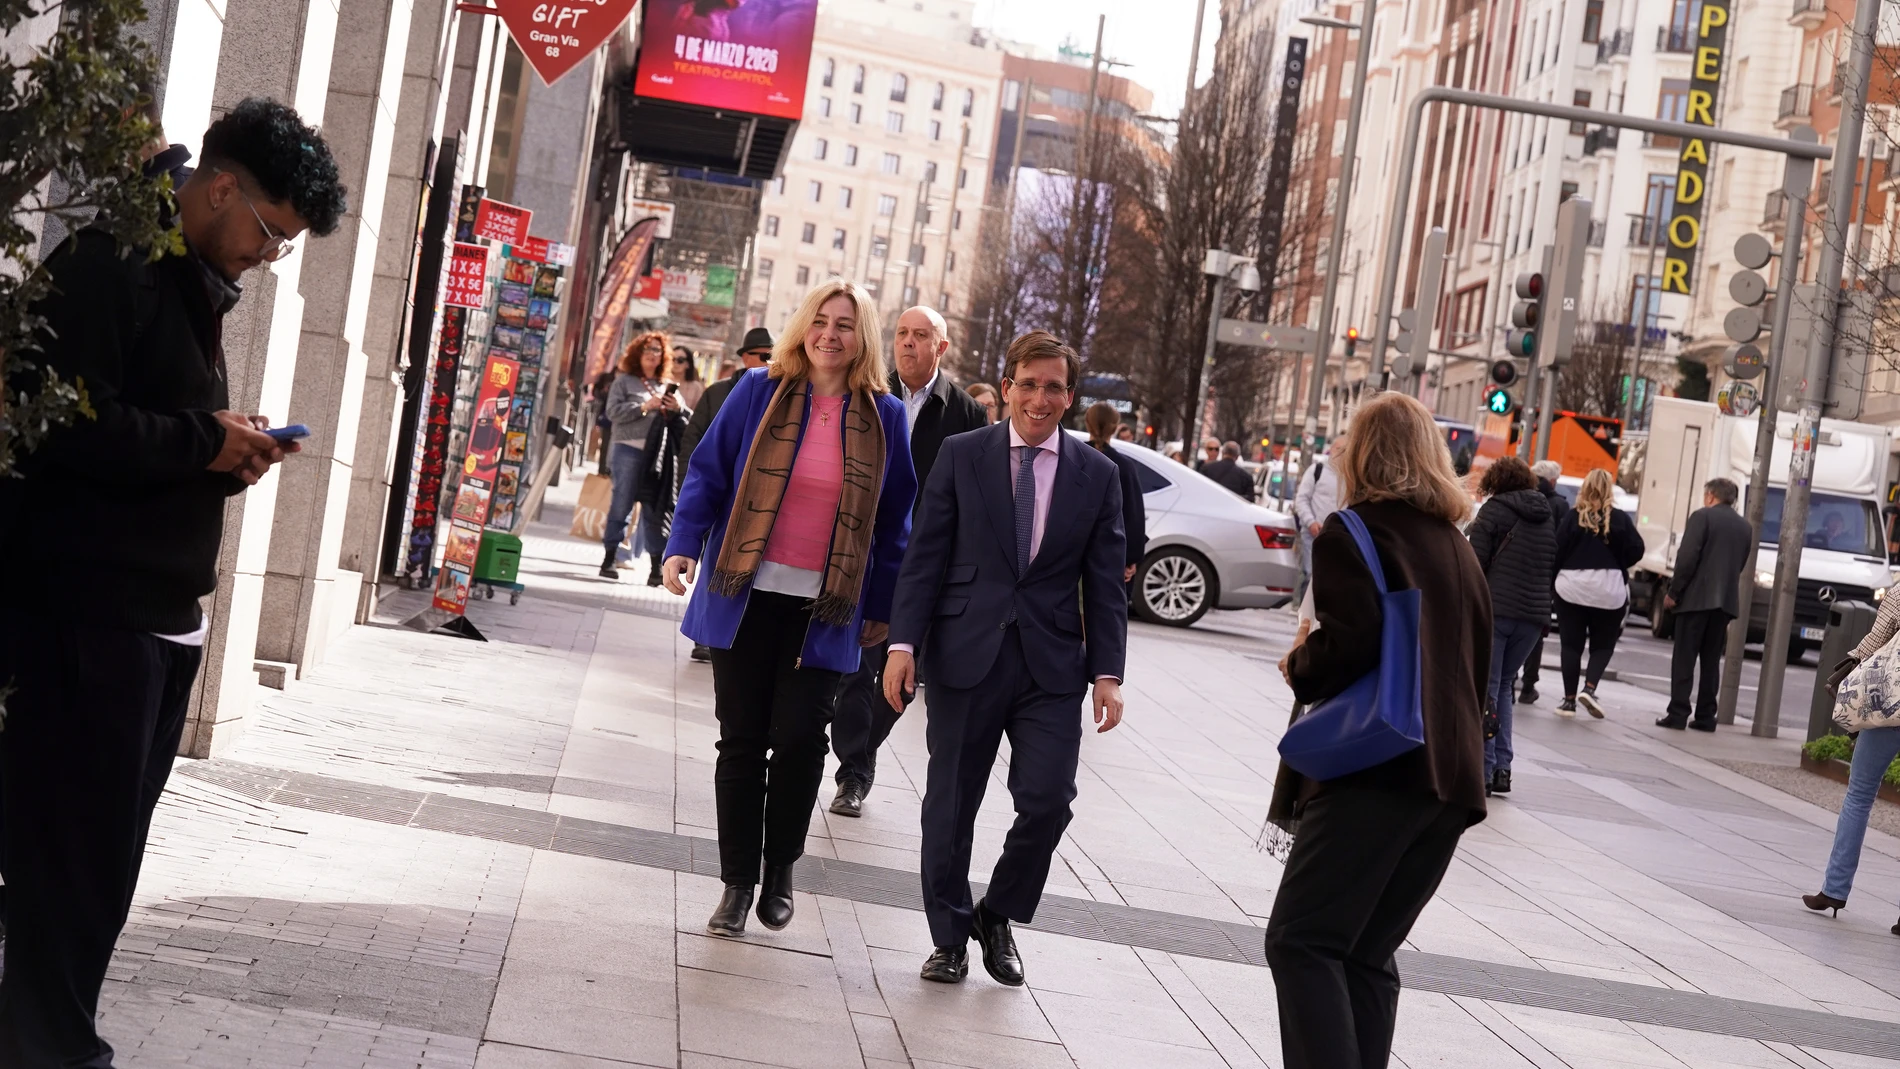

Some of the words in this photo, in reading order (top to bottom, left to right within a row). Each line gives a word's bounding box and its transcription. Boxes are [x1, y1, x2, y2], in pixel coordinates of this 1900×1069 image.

[532, 4, 588, 29] GIFT
[529, 30, 558, 44] Gran
[545, 47, 559, 58] 68
[674, 34, 686, 60] 4
[685, 36, 702, 62] DE
[702, 39, 745, 68] MARZO
[744, 46, 778, 73] 2026
[673, 61, 720, 78] TEATRO
[722, 68, 773, 86] CAPITOL
[1662, 5, 1727, 293] PERADOR
